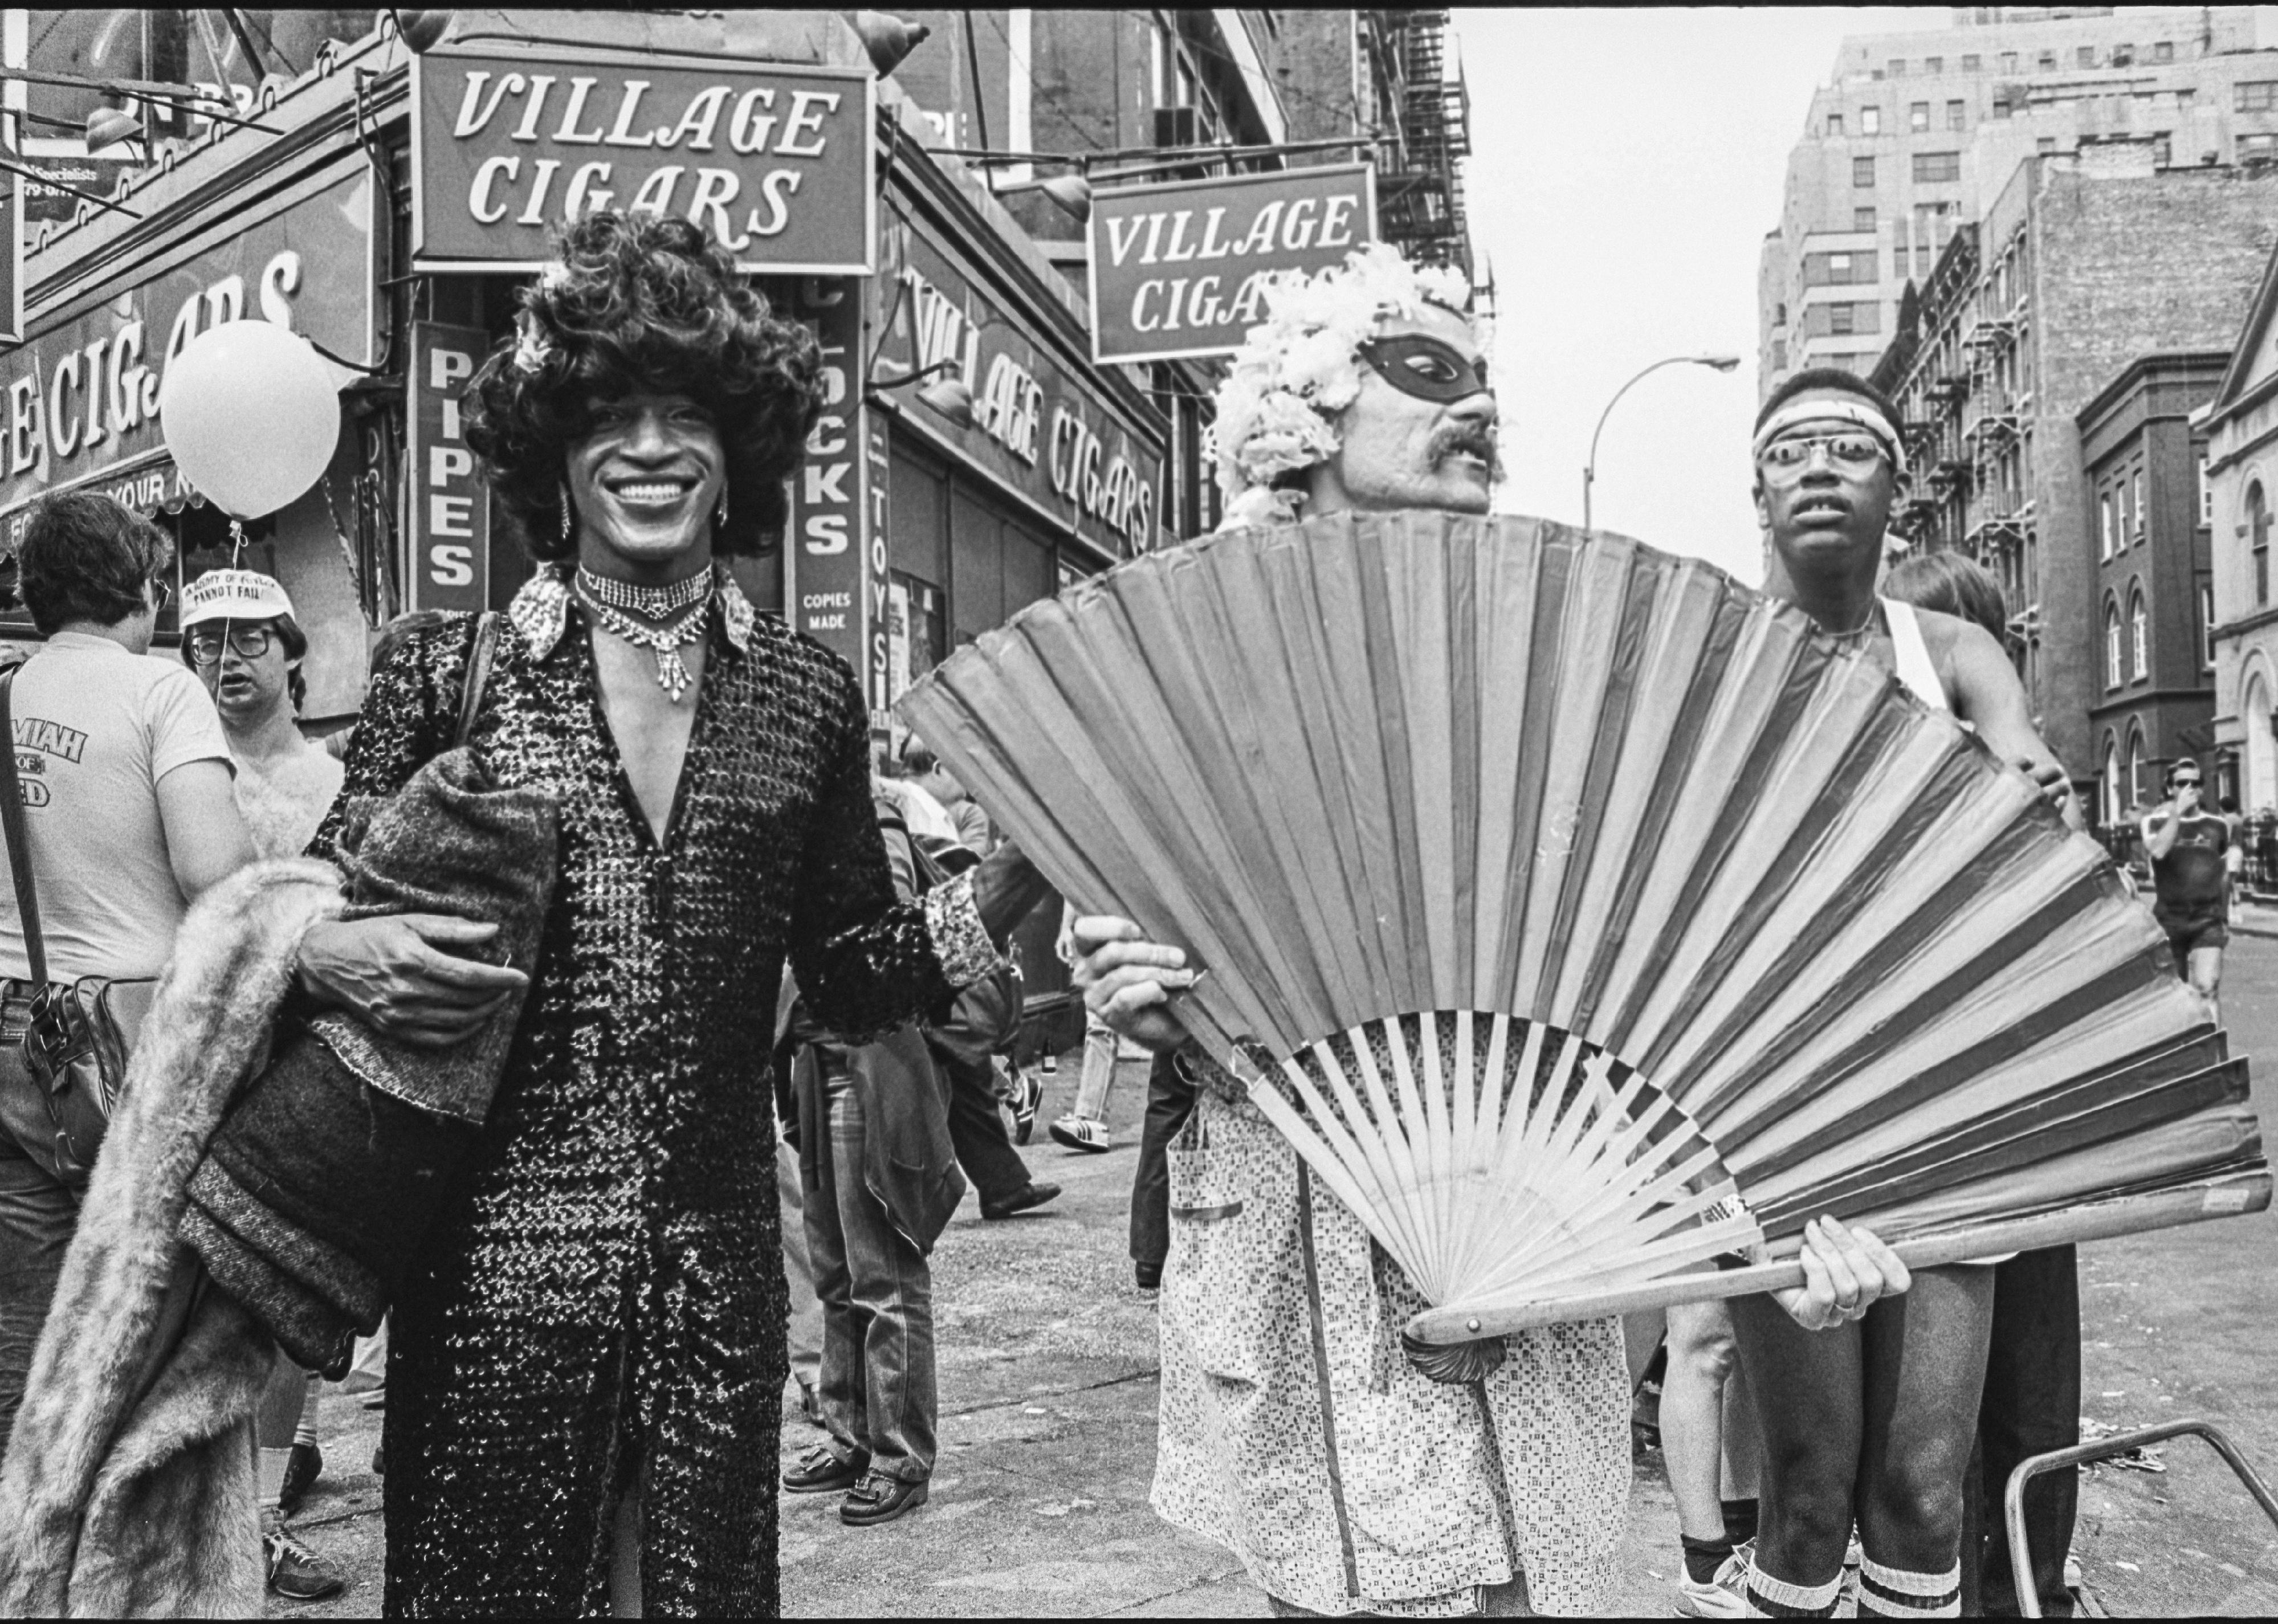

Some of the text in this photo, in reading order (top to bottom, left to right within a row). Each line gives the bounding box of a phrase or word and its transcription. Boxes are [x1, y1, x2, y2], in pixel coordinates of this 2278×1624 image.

[454, 72, 840, 156] VILLAGE
[468, 157, 801, 250] CIGARS
[1106, 194, 1358, 267] VILLAGE
[1131, 276, 1272, 332] CIGA
[107, 474, 165, 509] YOUR
[430, 348, 473, 586] PIPES
[1050, 405, 1152, 557] CIGARS
[803, 592, 851, 609] COPIES
[809, 614, 846, 629] MADE
